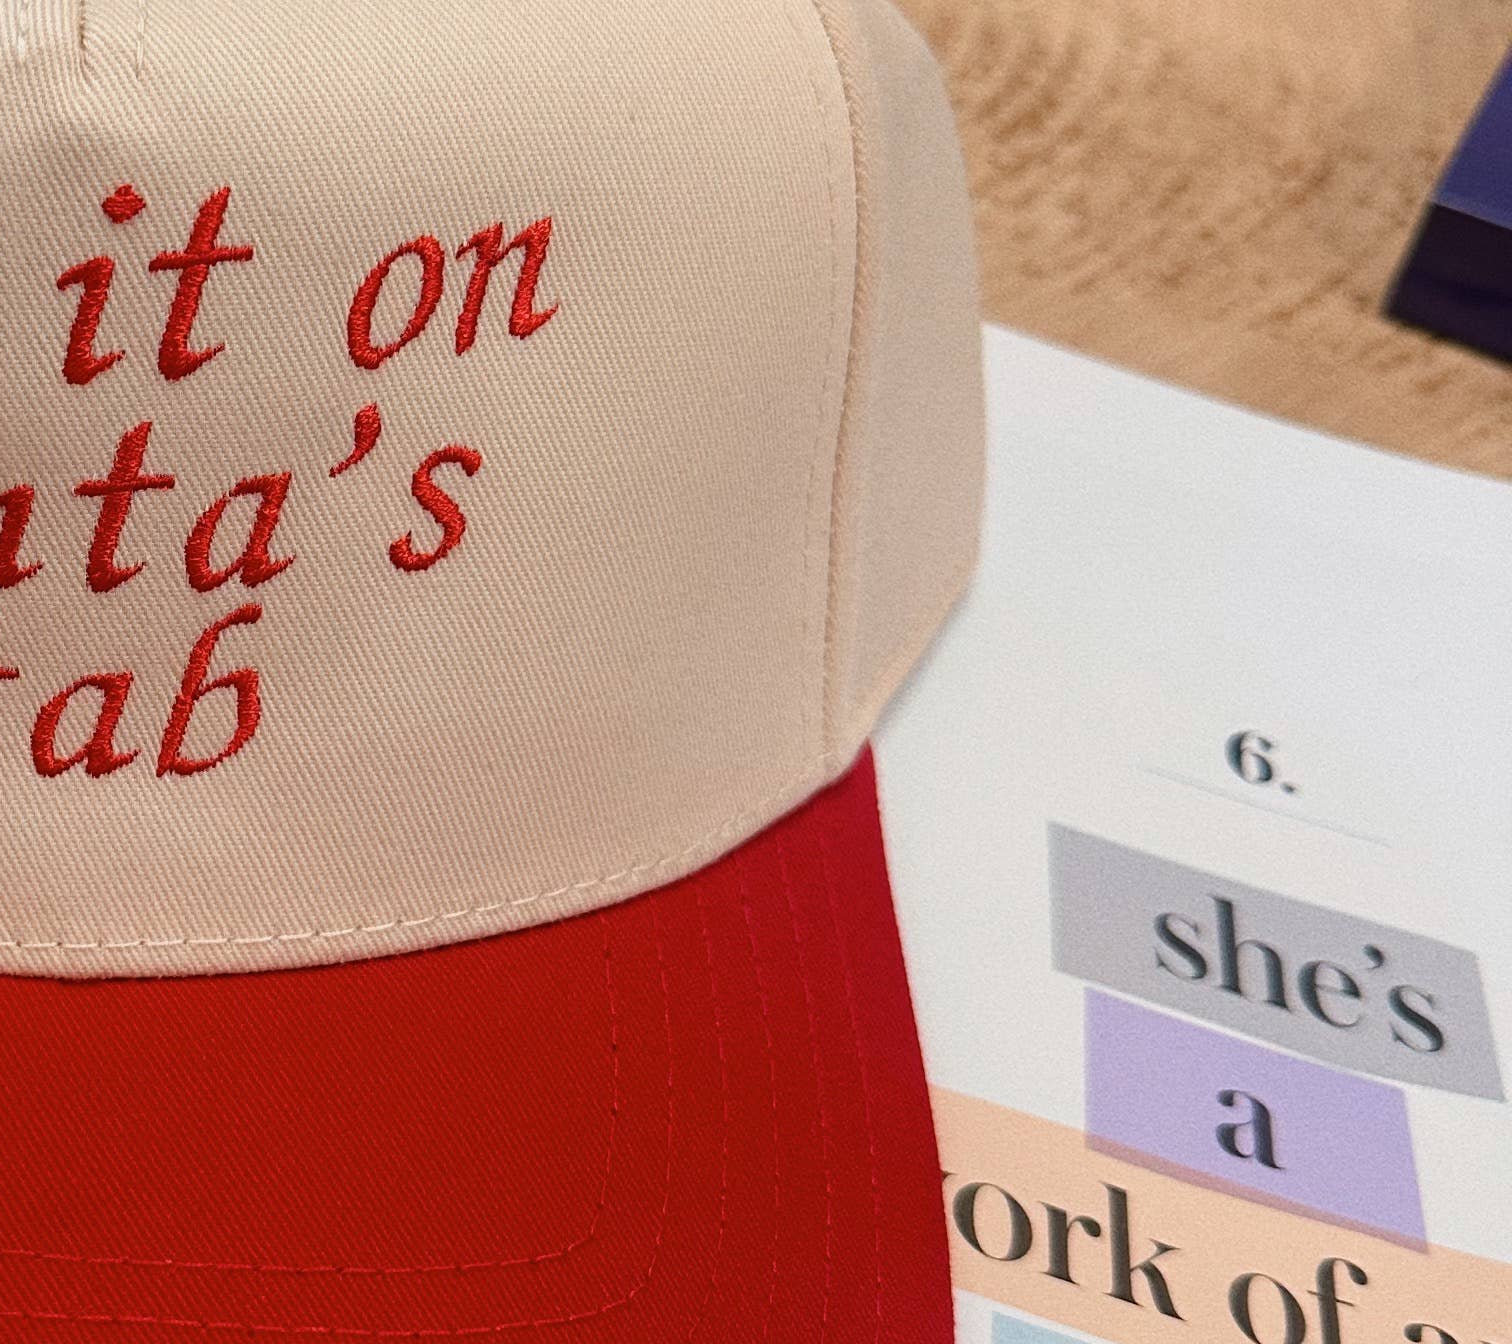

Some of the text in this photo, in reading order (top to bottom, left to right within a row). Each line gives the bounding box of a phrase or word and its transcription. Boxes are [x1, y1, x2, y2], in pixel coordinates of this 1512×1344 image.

[57, 184, 254, 386] it
[347, 217, 558, 370] on
[1224, 729, 1297, 794] 6.
[1153, 896, 1445, 1054] she's
[1216, 1088, 1284, 1171] a
[941, 1169, 1187, 1321] ork
